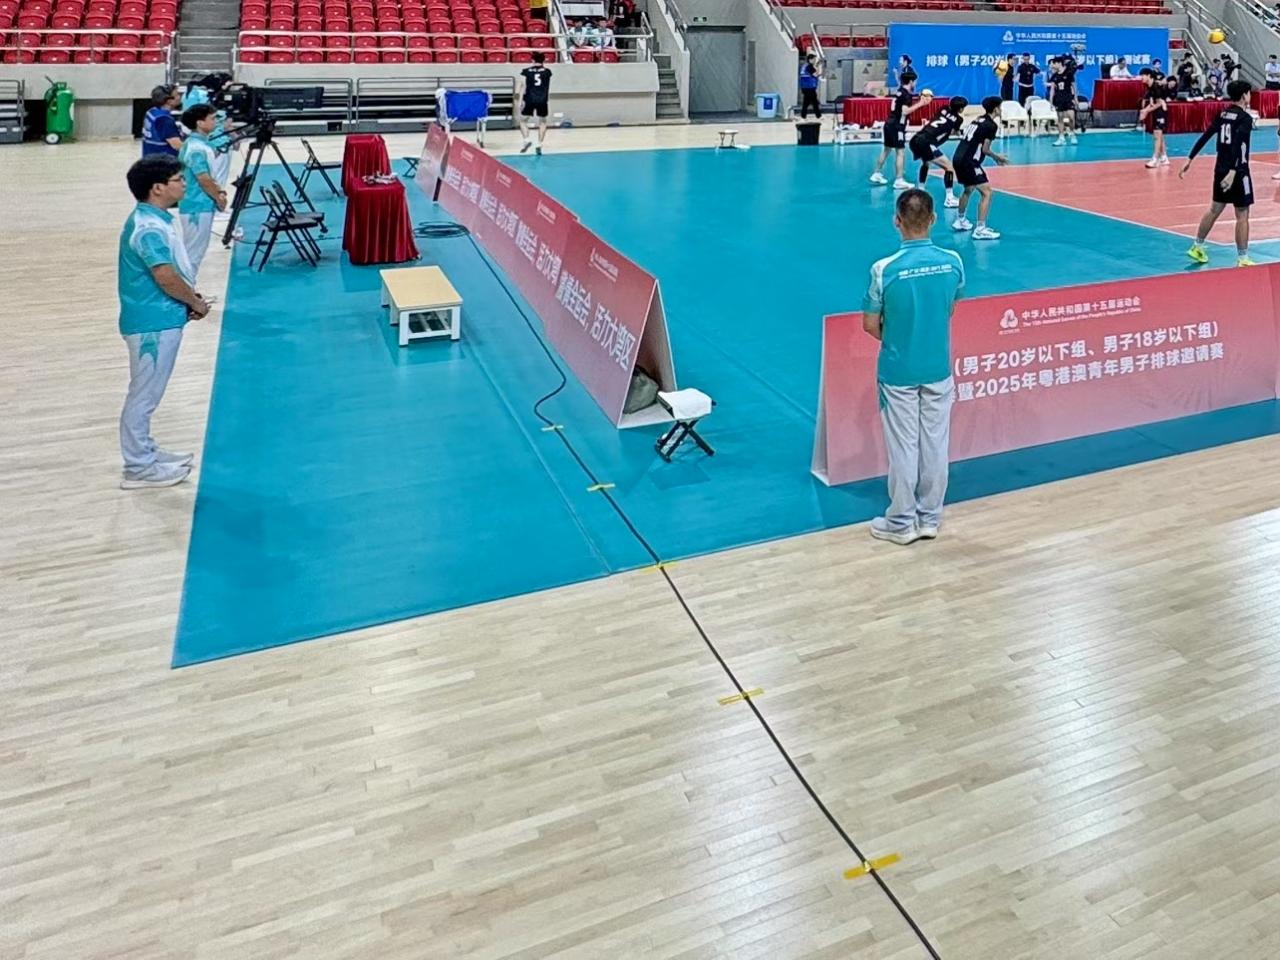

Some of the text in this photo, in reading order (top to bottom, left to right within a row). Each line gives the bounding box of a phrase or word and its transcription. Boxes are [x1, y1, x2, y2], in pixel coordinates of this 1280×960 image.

[533, 73, 542, 86] 5
[930, 116, 947, 128] 2
[1220, 123, 1232, 144] 19
[1021, 296, 1141, 321] 中华人民共和国第十五届运动会
[953, 320, 1219, 376] （男子20岁以下组、男子18岁以下组）
